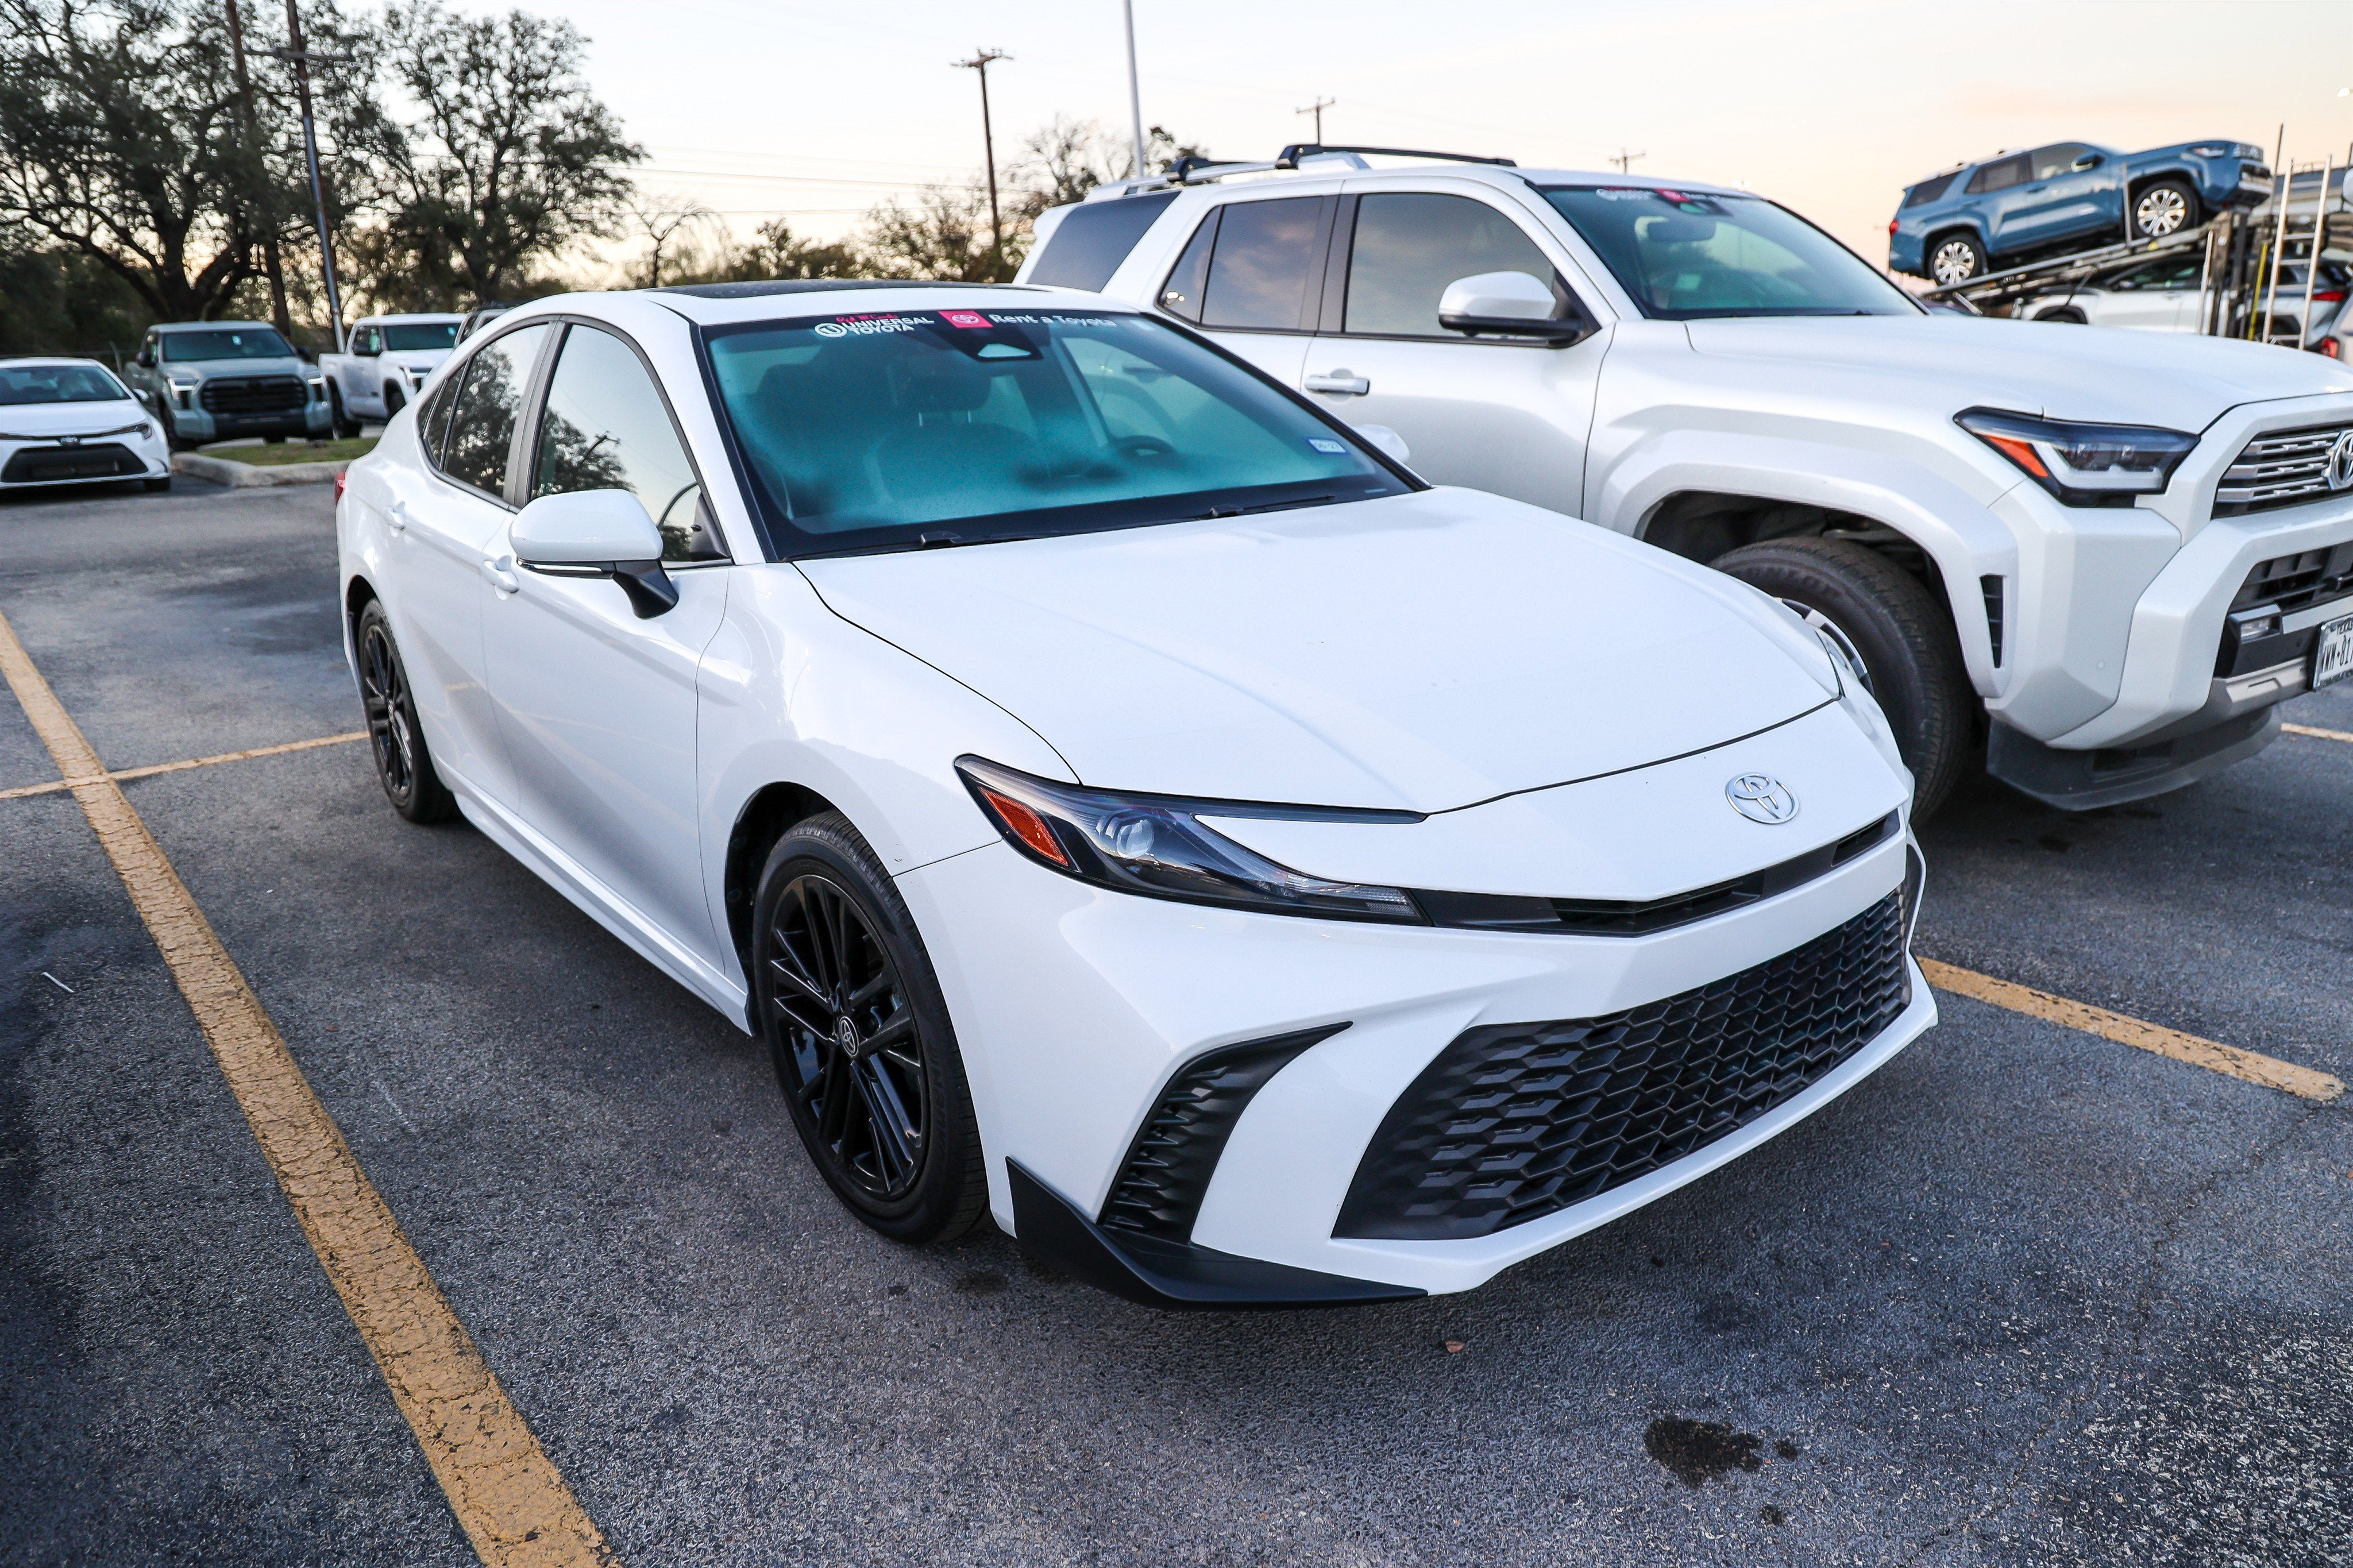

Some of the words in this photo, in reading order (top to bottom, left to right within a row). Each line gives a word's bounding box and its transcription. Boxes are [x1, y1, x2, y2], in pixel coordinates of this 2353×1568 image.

[841, 316, 935, 329] UNIVERSAL
[988, 314, 1039, 323] Rent
[1052, 315, 1117, 327] Toyota
[848, 323, 915, 335] TOYOTA
